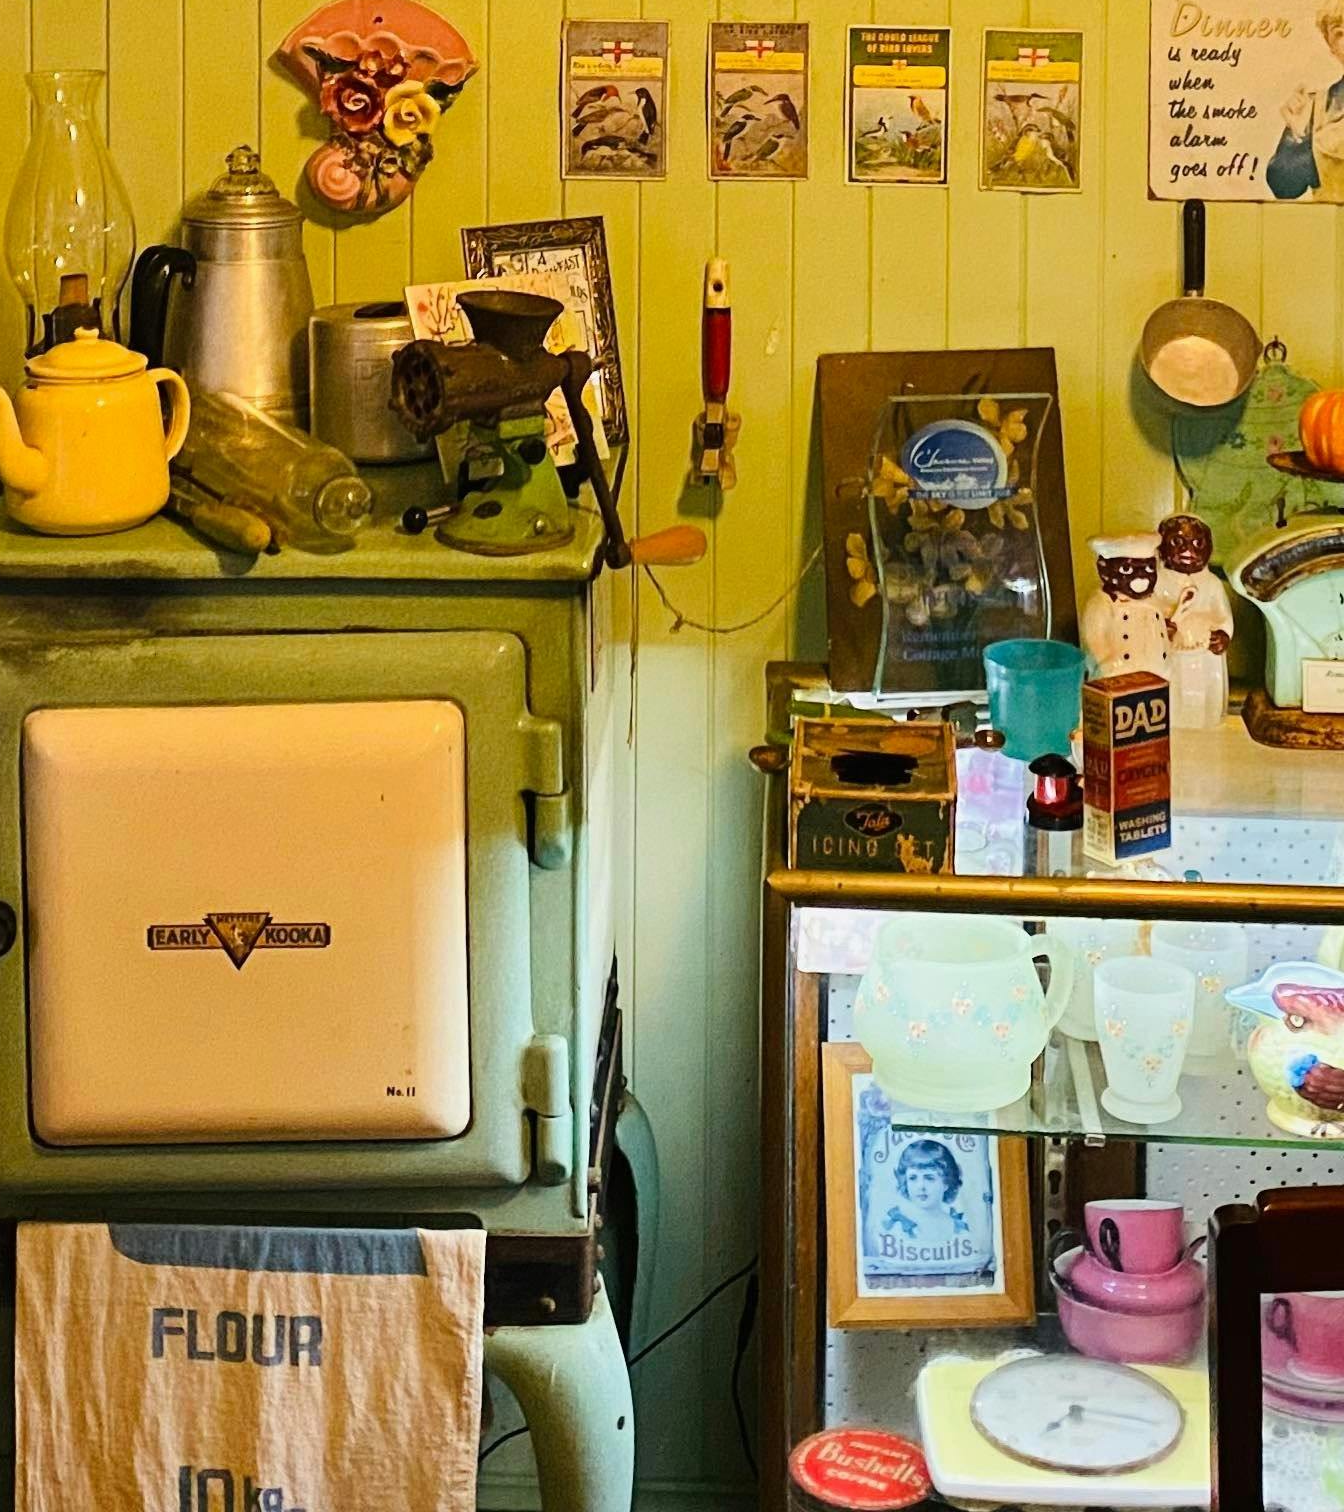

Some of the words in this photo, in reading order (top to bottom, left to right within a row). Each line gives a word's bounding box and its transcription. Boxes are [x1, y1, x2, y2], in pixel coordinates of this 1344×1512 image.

[1167, 0, 1293, 39] Dinner
[1167, 45, 1181, 63] is
[1191, 41, 1242, 67] ready
[1168, 69, 1215, 91] when
[1168, 99, 1198, 120] the
[1201, 98, 1258, 121] smoke
[1169, 123, 1228, 148] alarm
[1169, 158, 1208, 183] goes
[1114, 698, 1167, 740] DAD
[1118, 810, 1167, 832] WASHING
[1119, 822, 1168, 843] TABLETS
[156, 928, 211, 946] EARLY
[265, 926, 323, 945] KOOKA
[879, 1233, 979, 1263] Biscuits.
[150, 1307, 324, 1368] FLOUR
[816, 1440, 925, 1487] Bushells
[178, 1464, 234, 1512] 10
